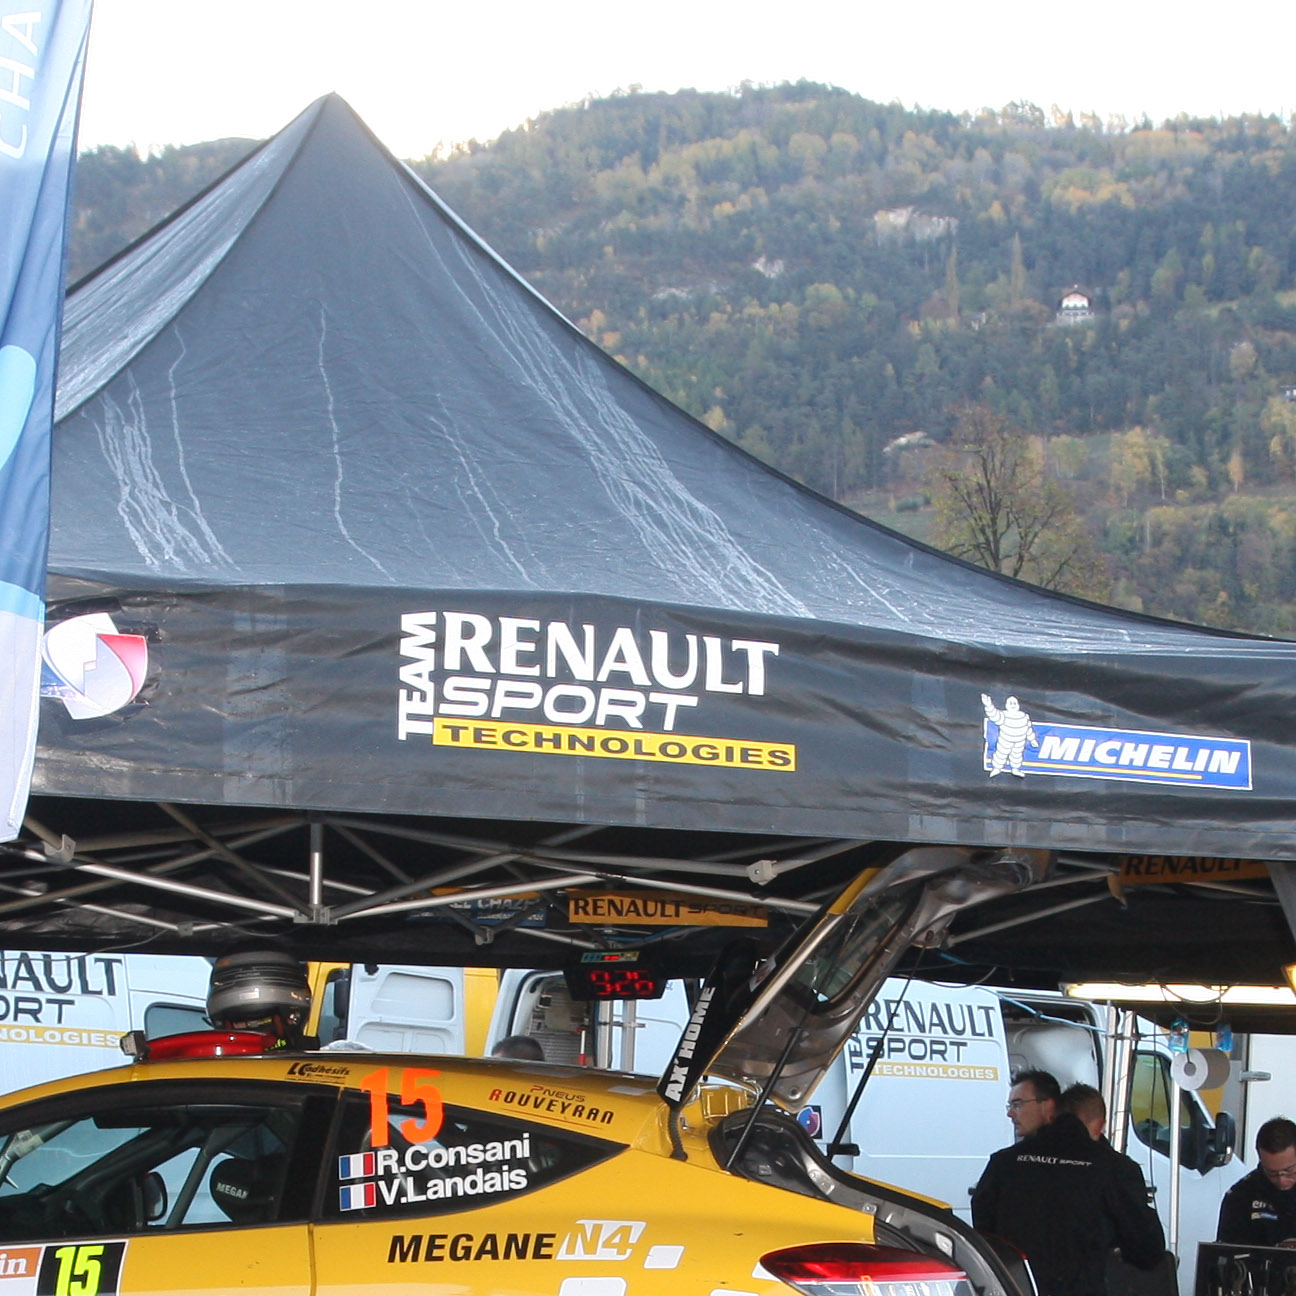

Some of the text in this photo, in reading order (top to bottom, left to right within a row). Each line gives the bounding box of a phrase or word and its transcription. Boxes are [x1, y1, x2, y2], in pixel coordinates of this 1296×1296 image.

[442, 611, 780, 696] RENAULT
[398, 611, 437, 741] TEAM
[438, 676, 699, 732] SPORT
[442, 725, 792, 767] TECHNOLOGIES
[1037, 734, 1242, 775] MICHELIN
[1125, 856, 1241, 876] RENAULT
[573, 898, 763, 919] RENAULT SPORT
[861, 998, 996, 1038] RENAULT
[865, 1036, 968, 1063] SPORT
[875, 1064, 995, 1080] TECHNOLOGIES
[360, 1067, 445, 1149] 15
[488, 1088, 615, 1125] ROUVEYRAN
[529, 1085, 587, 1103] PNEUS
[376, 1132, 530, 1177] R.Consani
[378, 1168, 528, 1207] V.Landais
[387, 1223, 635, 1264] MEGANE N4
